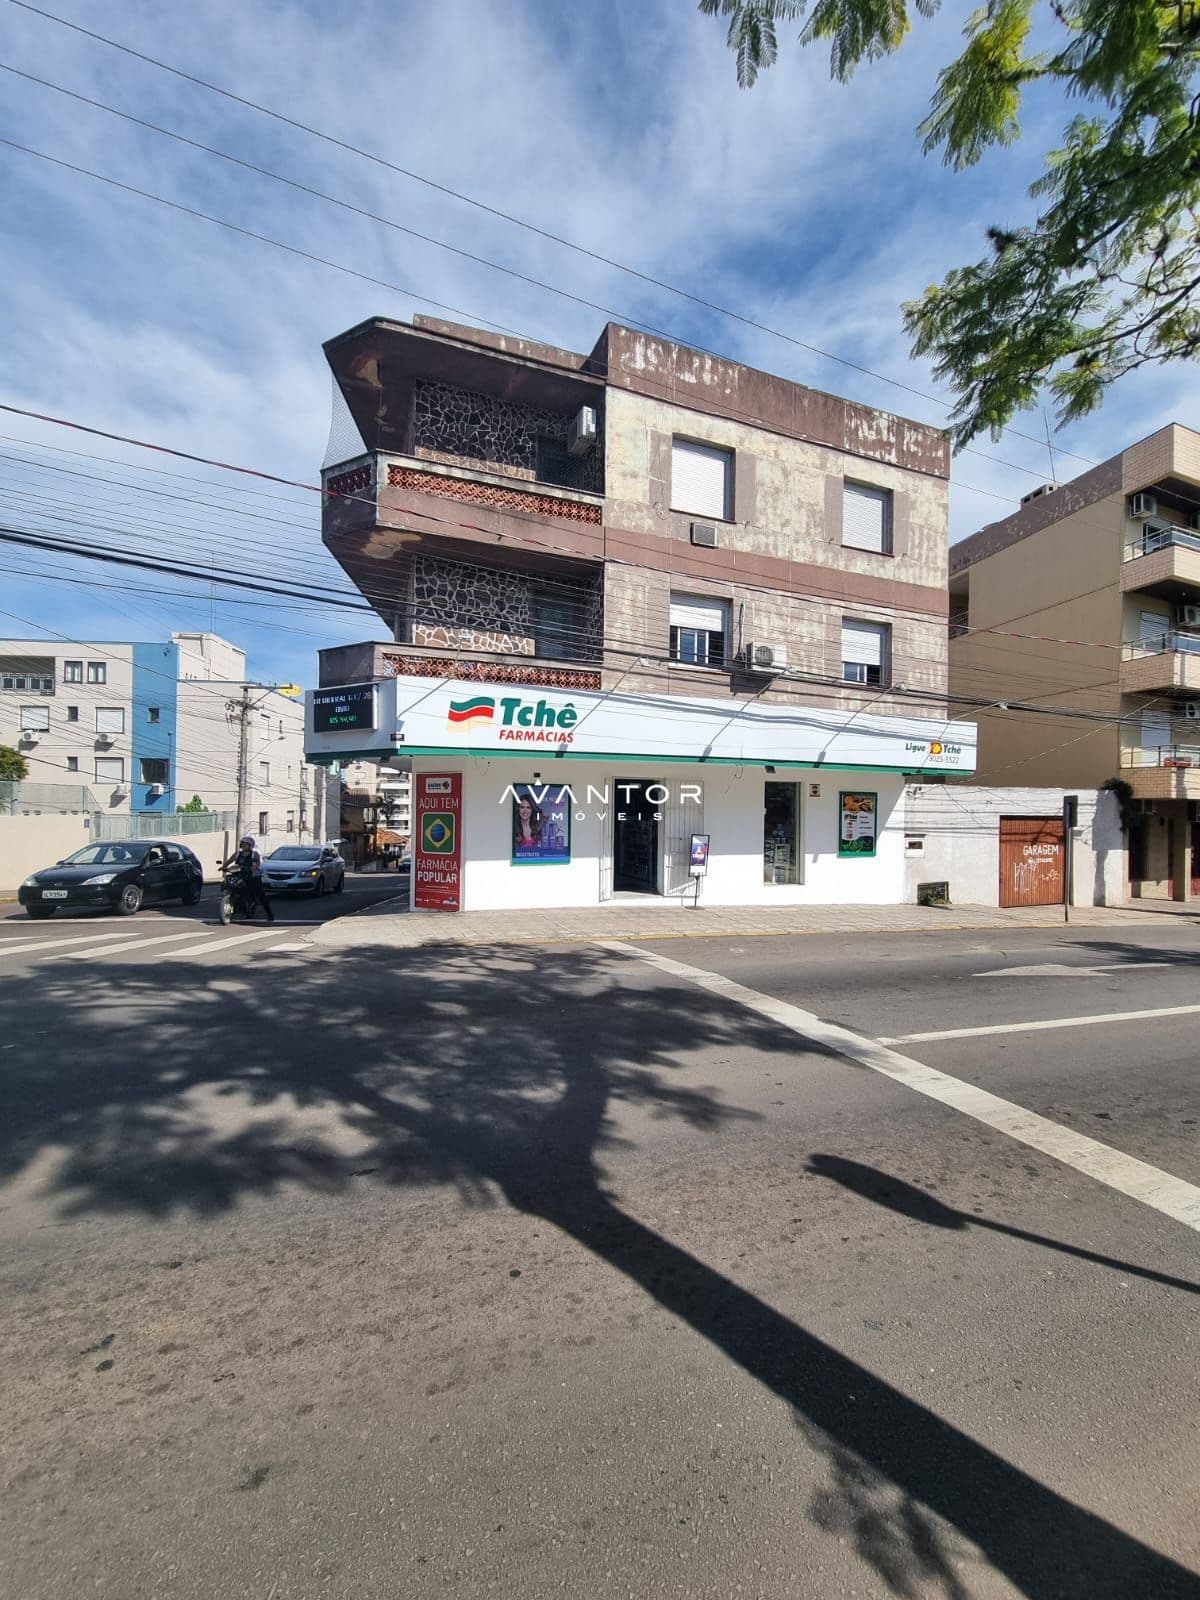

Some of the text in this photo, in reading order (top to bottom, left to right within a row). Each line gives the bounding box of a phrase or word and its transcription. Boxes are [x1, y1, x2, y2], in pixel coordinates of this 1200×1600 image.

[500, 698, 578, 729] Tchê
[498, 728, 574, 744] FARMÁCIAS
[905, 742, 927, 754] Ligue
[418, 797, 459, 809] AQUI TEM
[1022, 844, 1059, 856] GARAGEM
[416, 857, 458, 872] FARMÁCIA
[417, 870, 457, 884] POPULAR
